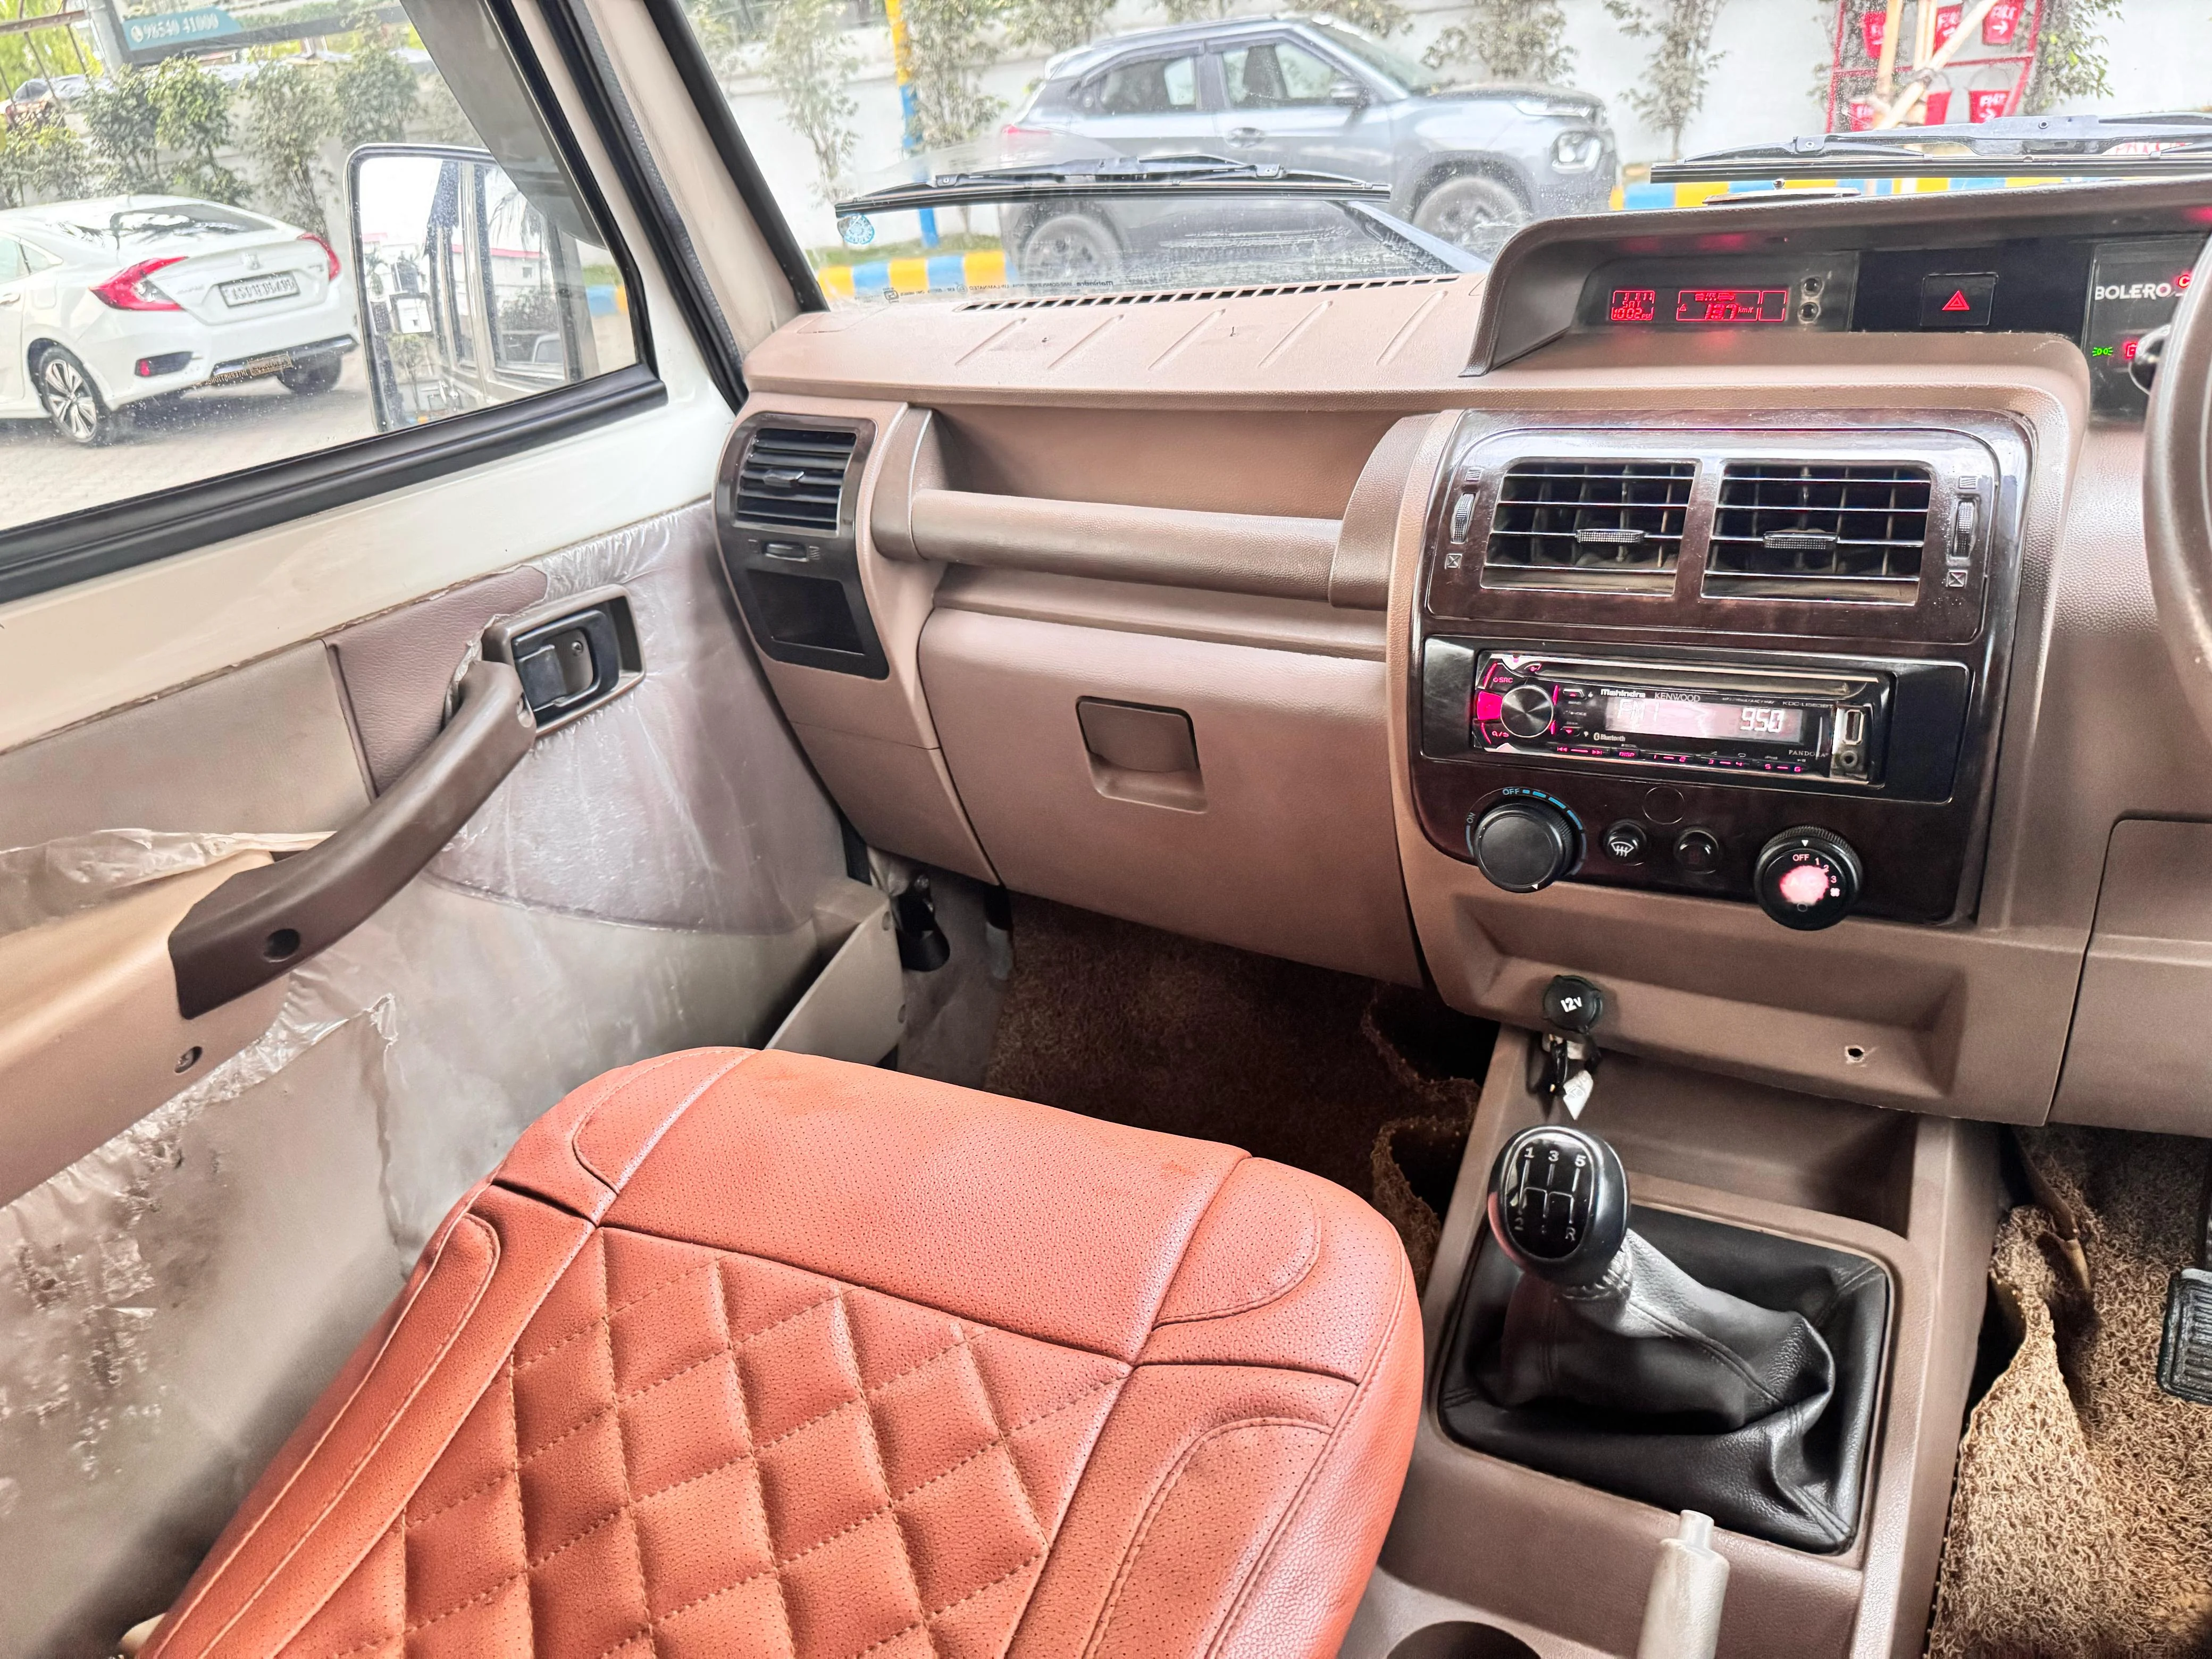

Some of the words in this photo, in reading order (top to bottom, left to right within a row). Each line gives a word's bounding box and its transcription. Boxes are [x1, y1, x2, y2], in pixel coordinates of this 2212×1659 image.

[2094, 282, 2172, 300] BOLERO
[1655, 692, 1700, 702] KENWOOD
[1601, 733, 1626, 742] Bluetooth
[1466, 812, 1476, 824] ON
[1815, 857, 1820, 866] 1
[1524, 1146, 1535, 1158] 1
[1548, 1150, 1560, 1161] 3
[1574, 1154, 1587, 1167] 5
[1565, 1227, 1576, 1242] R
